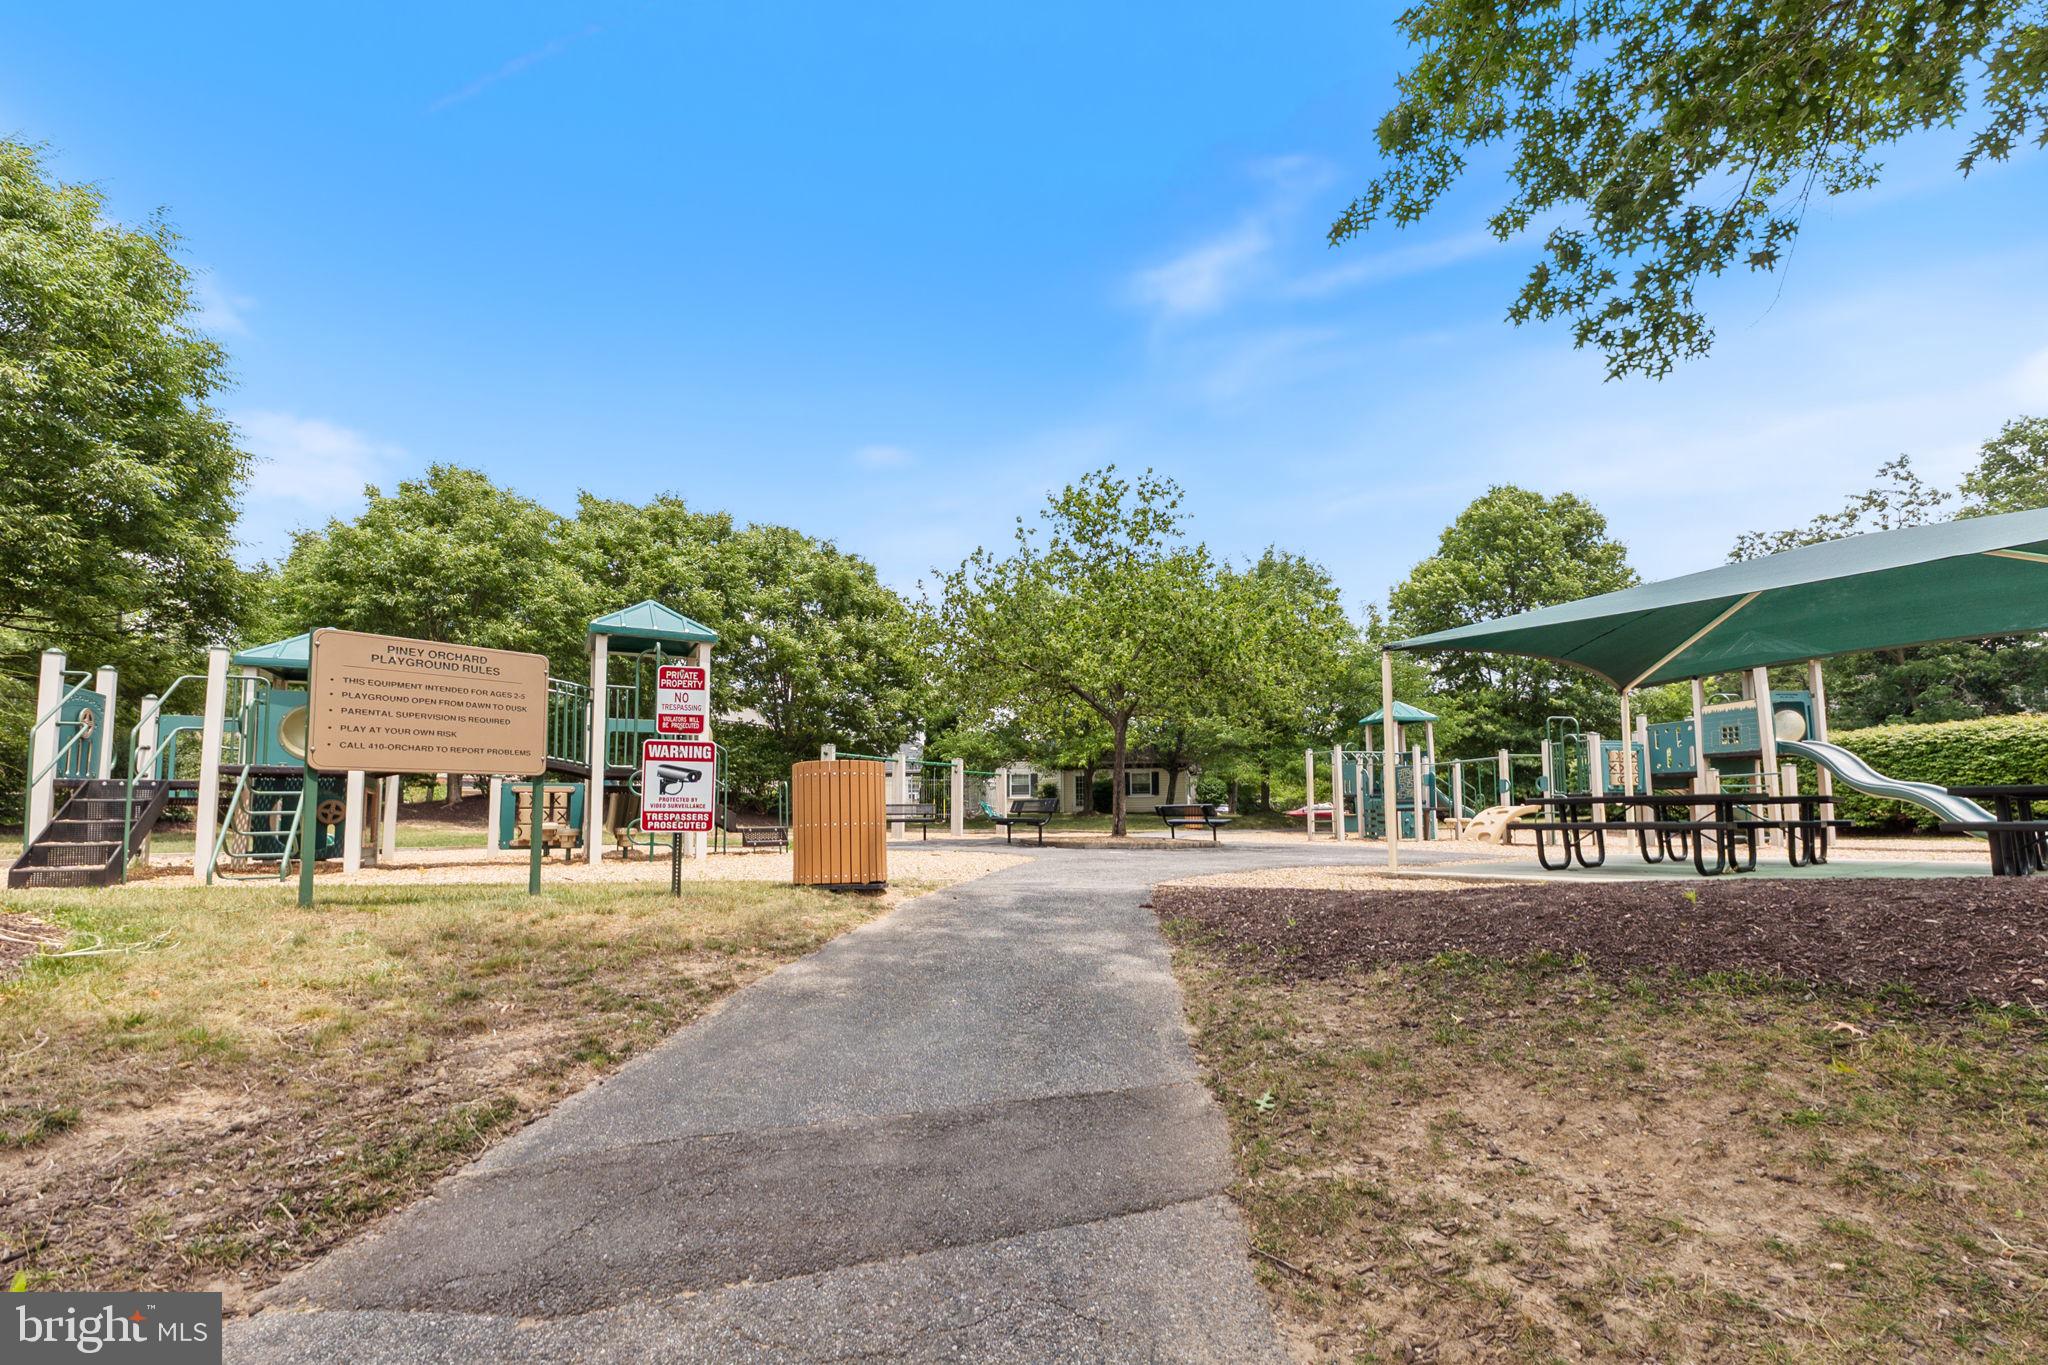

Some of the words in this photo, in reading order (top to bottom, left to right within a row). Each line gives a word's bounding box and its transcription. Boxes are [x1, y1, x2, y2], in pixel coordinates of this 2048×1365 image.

[387, 645, 424, 657] PINEY
[428, 650, 488, 664] ORCHARD
[371, 654, 459, 671] PLAYGROUND
[462, 664, 500, 676] RULES
[666, 670, 699, 680] PRIVATE
[343, 676, 365, 686] THIS
[367, 679, 422, 691] EQUIPMENT
[425, 684, 469, 695] INTENDED
[490, 690, 513, 699] AGES
[660, 679, 703, 688] PROPERTY
[341, 691, 409, 704] PLAYGROUND
[411, 697, 437, 705] OPEN
[438, 699, 464, 708] FROM
[465, 701, 491, 710] DAWN
[493, 703, 504, 711] TO
[505, 704, 527, 713] DUSK
[674, 692, 689, 703] NO
[662, 703, 702, 712] TRESPASSING
[341, 707, 393, 718] PARENTAL
[395, 711, 457, 722] SUPERVISION
[468, 716, 511, 726] REQUIRED
[340, 725, 366, 733] PLAY
[368, 726, 382, 734] AT
[384, 727, 411, 736] YOUR
[412, 728, 435, 737] OWN
[436, 730, 457, 738] RISK
[339, 741, 366, 750] CALL
[368, 743, 434, 753] 410-ORCHARD
[436, 745, 448, 753] TO
[450, 746, 485, 755] REPORT
[487, 748, 532, 757] PROBLEMS
[648, 744, 712, 759] WARNING
[646, 812, 710, 821] TRESPASSERS
[647, 821, 707, 830] PROSECUTED
